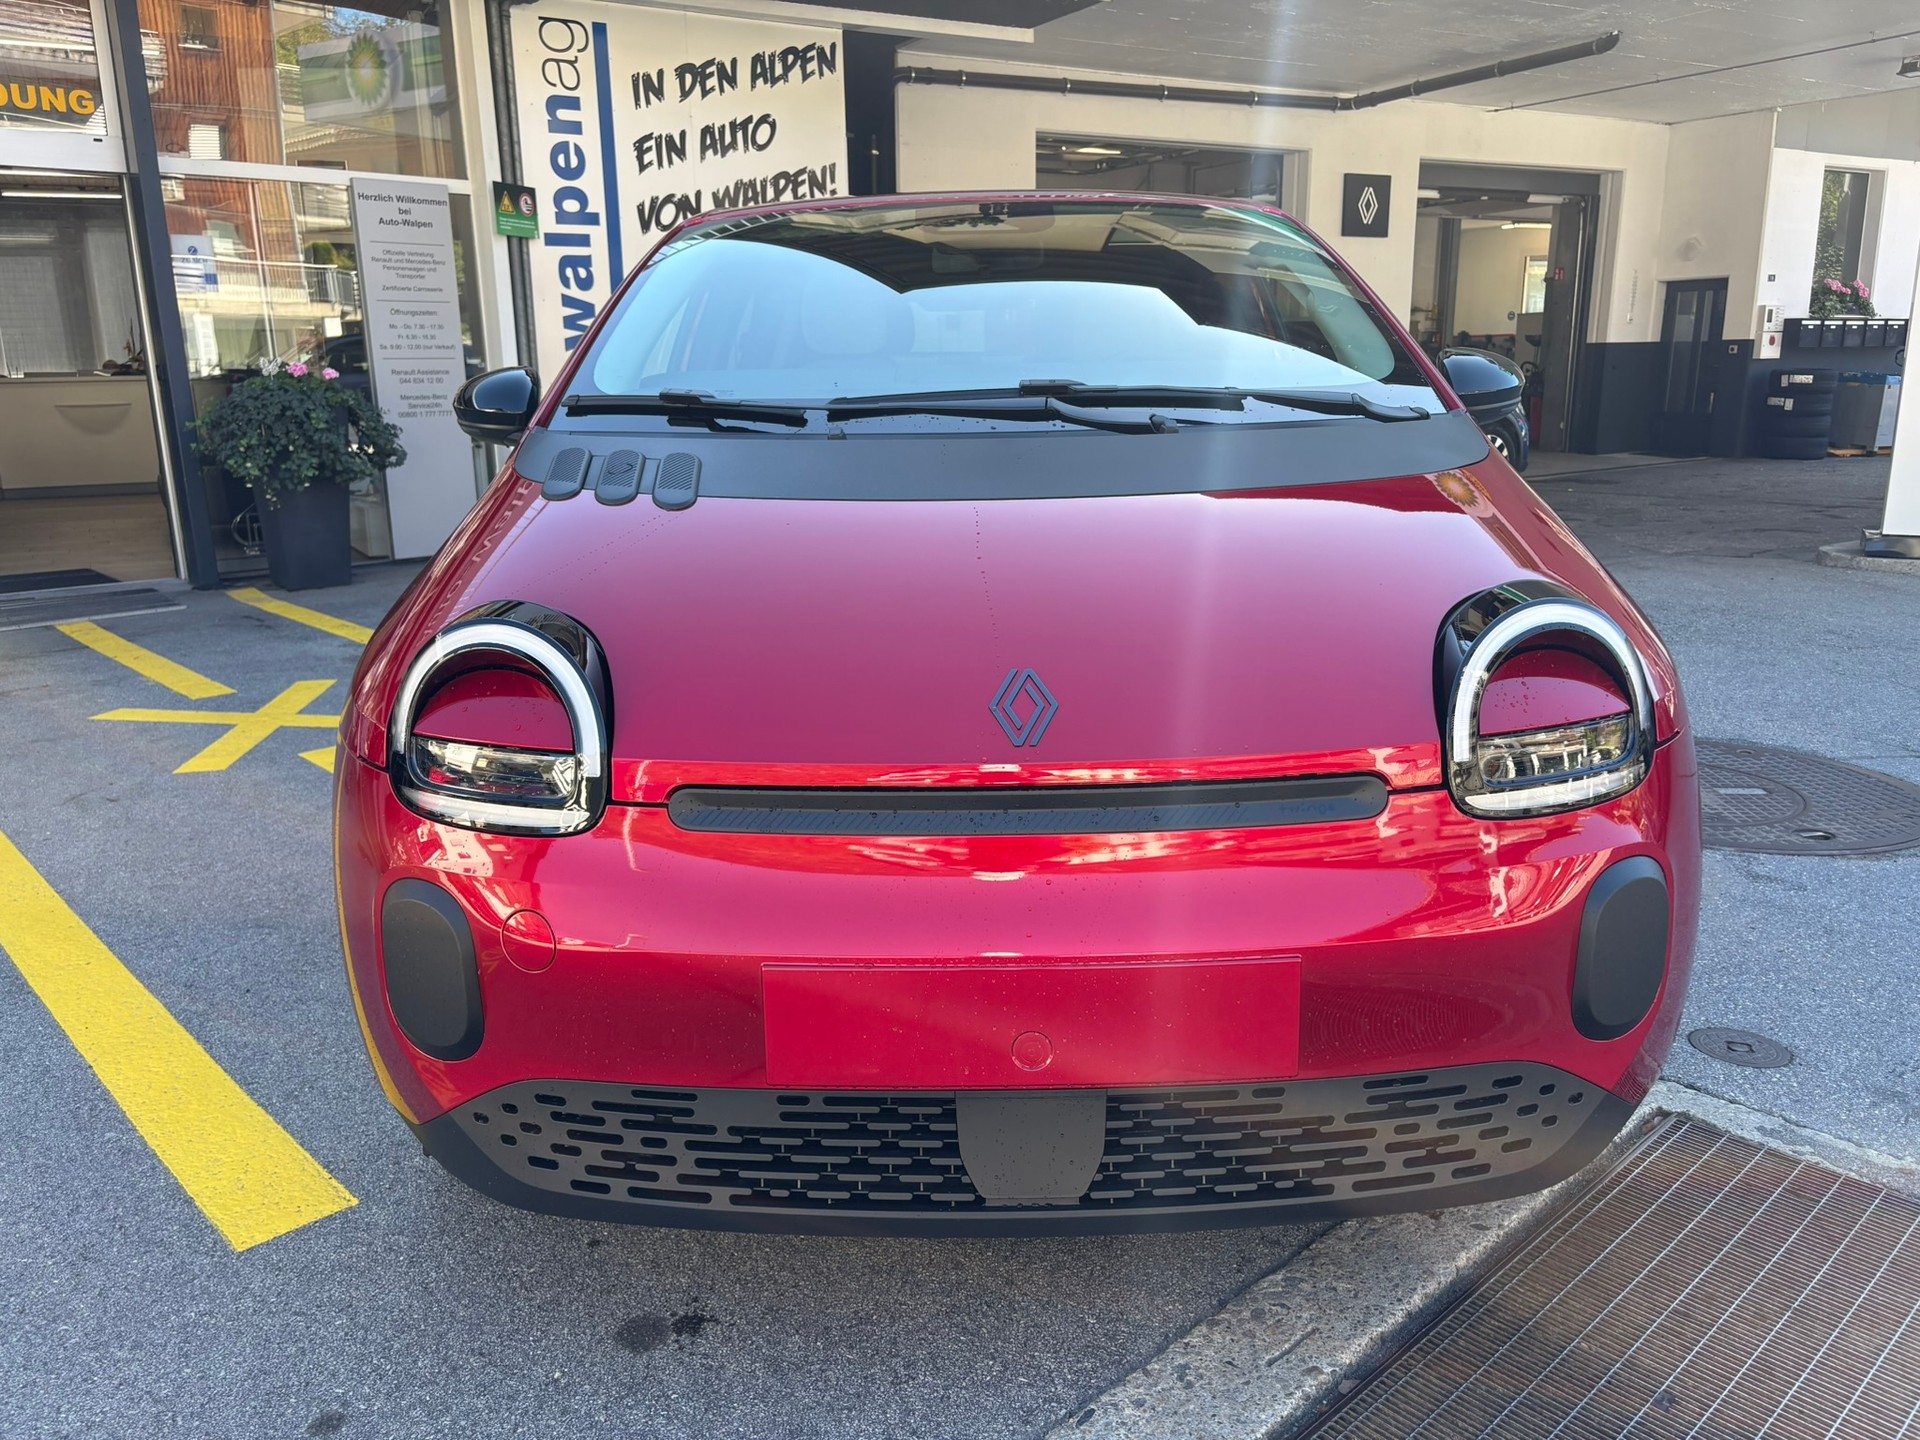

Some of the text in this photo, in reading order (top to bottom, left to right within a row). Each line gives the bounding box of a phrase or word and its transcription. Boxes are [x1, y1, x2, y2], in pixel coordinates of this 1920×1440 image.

[631, 42, 837, 110] IN DEN ALPEN
[633, 113, 777, 175] EIN AUTO
[357, 192, 448, 207] Herzlich Willkommen
[398, 207, 412, 216] bei
[636, 162, 838, 235] VON WALPEN!
[379, 217, 433, 229] Auto-Walpen
